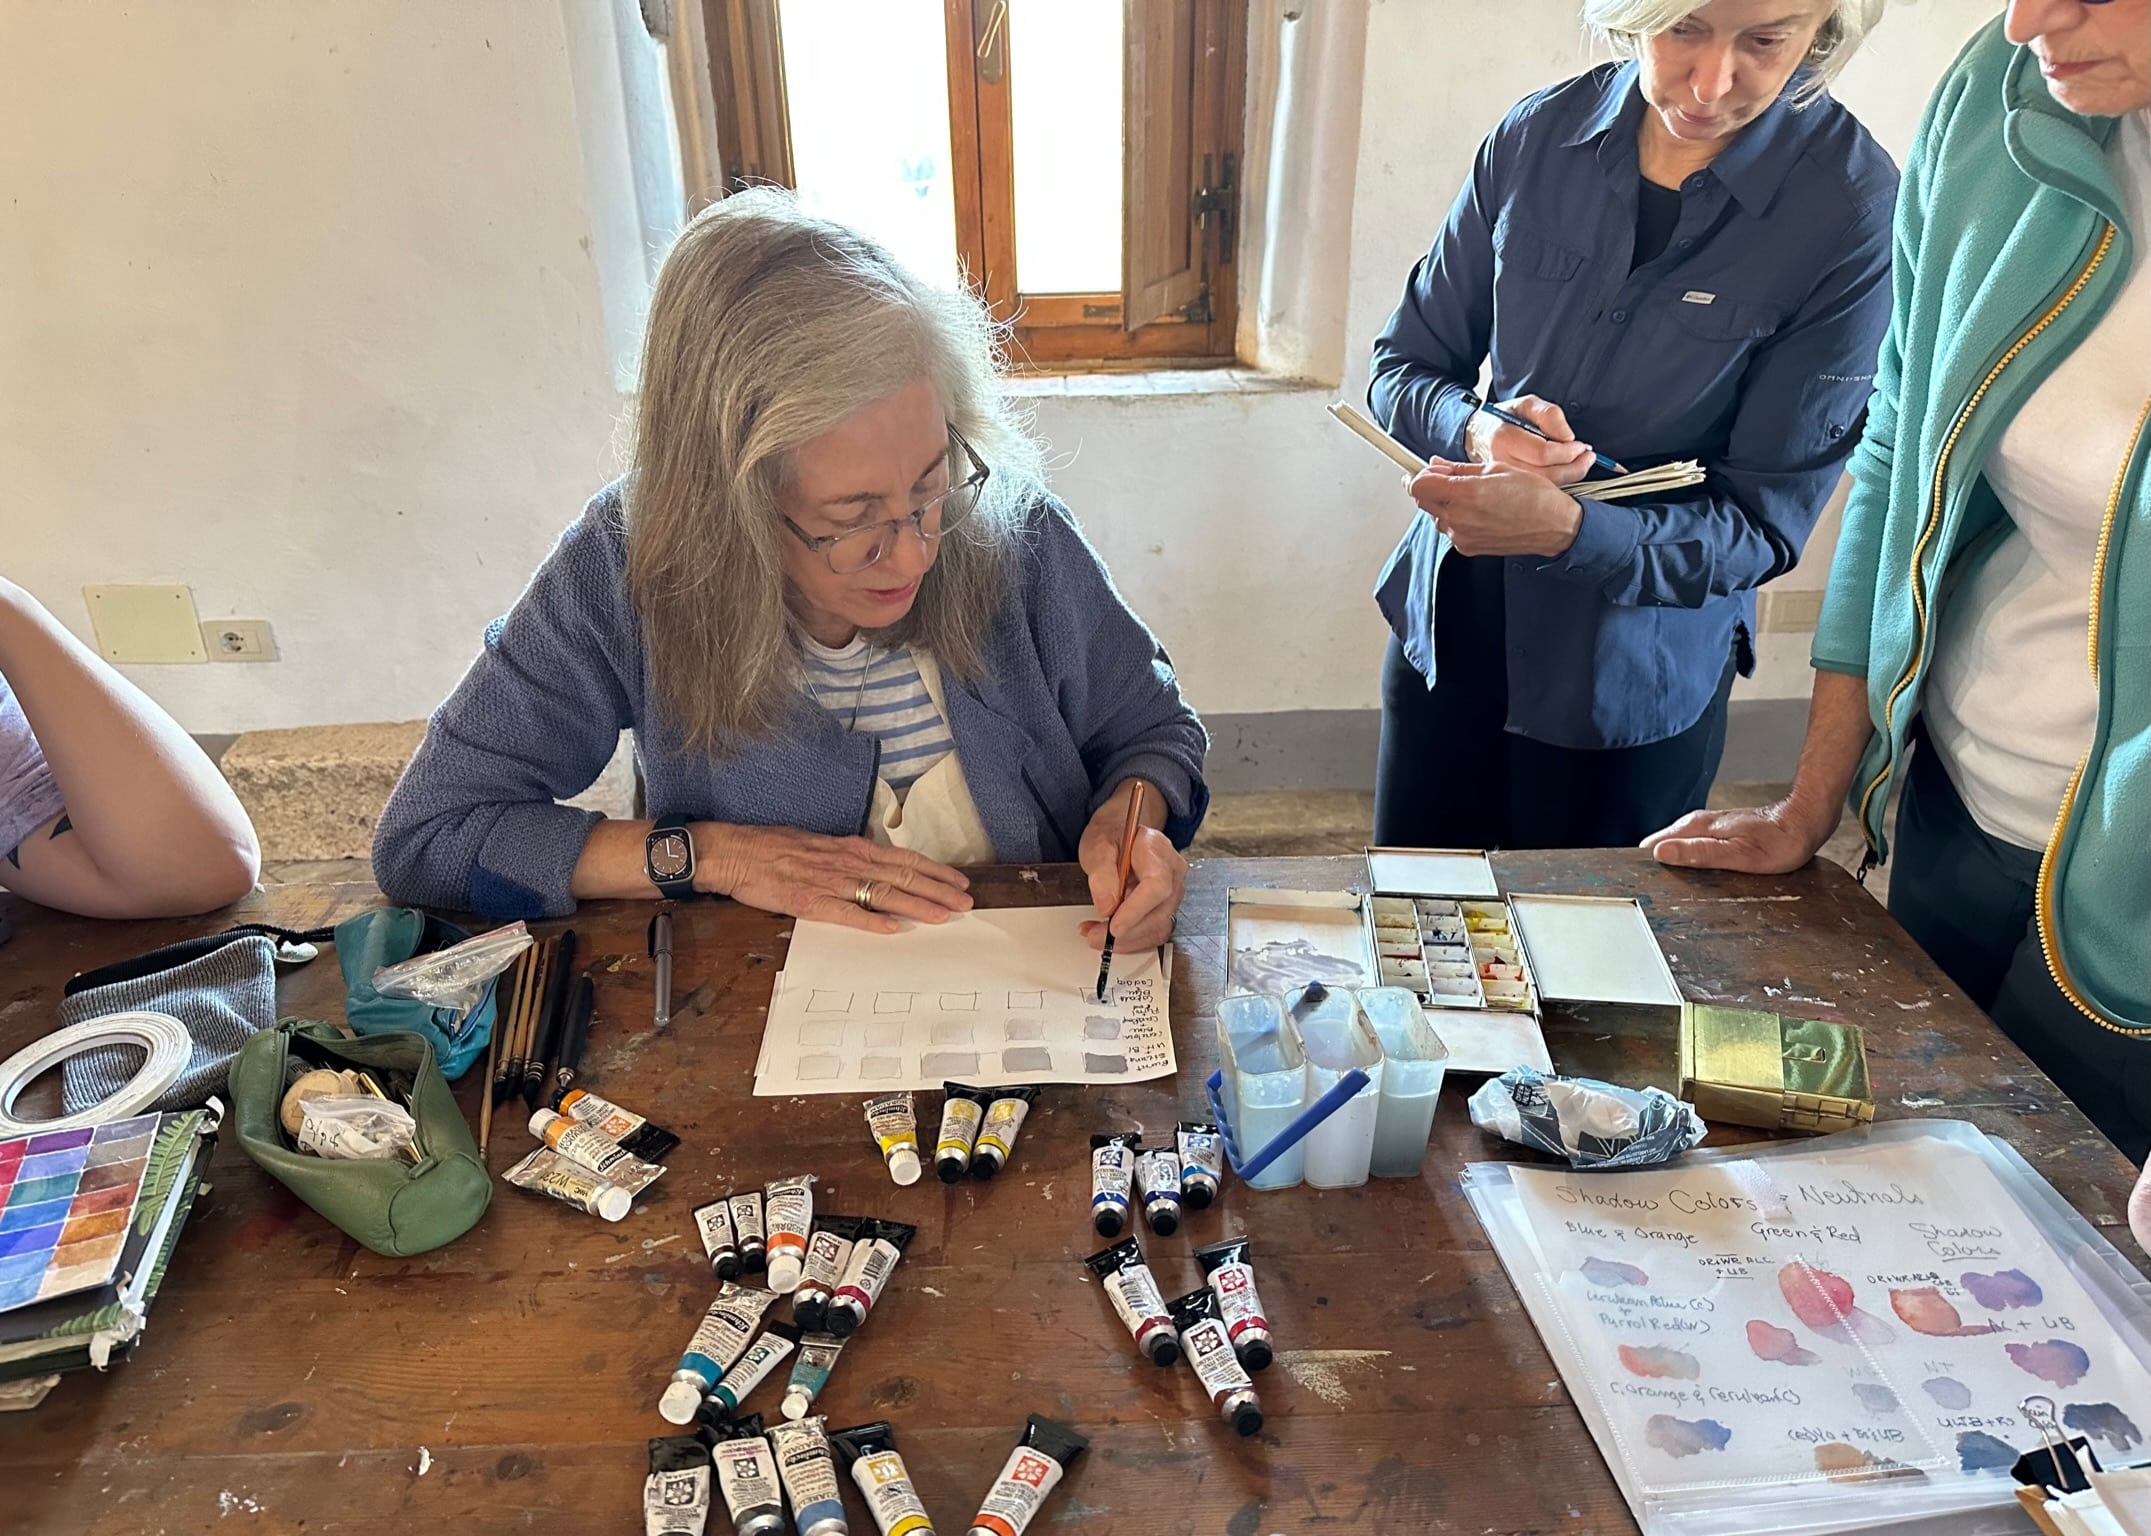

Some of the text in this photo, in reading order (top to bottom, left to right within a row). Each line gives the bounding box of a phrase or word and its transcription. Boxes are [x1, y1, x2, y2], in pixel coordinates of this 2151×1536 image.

[1819, 374, 1873, 383] OMNI-SHA
[599, 1150, 627, 1172] Schminck
[1556, 1186, 1658, 1211] Shadow
[1669, 1189, 1758, 1214] Colors
[1798, 1180, 1924, 1206] Neutrals
[1565, 1221, 1607, 1239] Blue
[1635, 1227, 1698, 1248] Orange
[1751, 1222, 1807, 1240] Green
[1826, 1225, 1861, 1243] Red
[1909, 1222, 2003, 1240] Shadow
[1928, 1241, 2002, 1258] Colors
